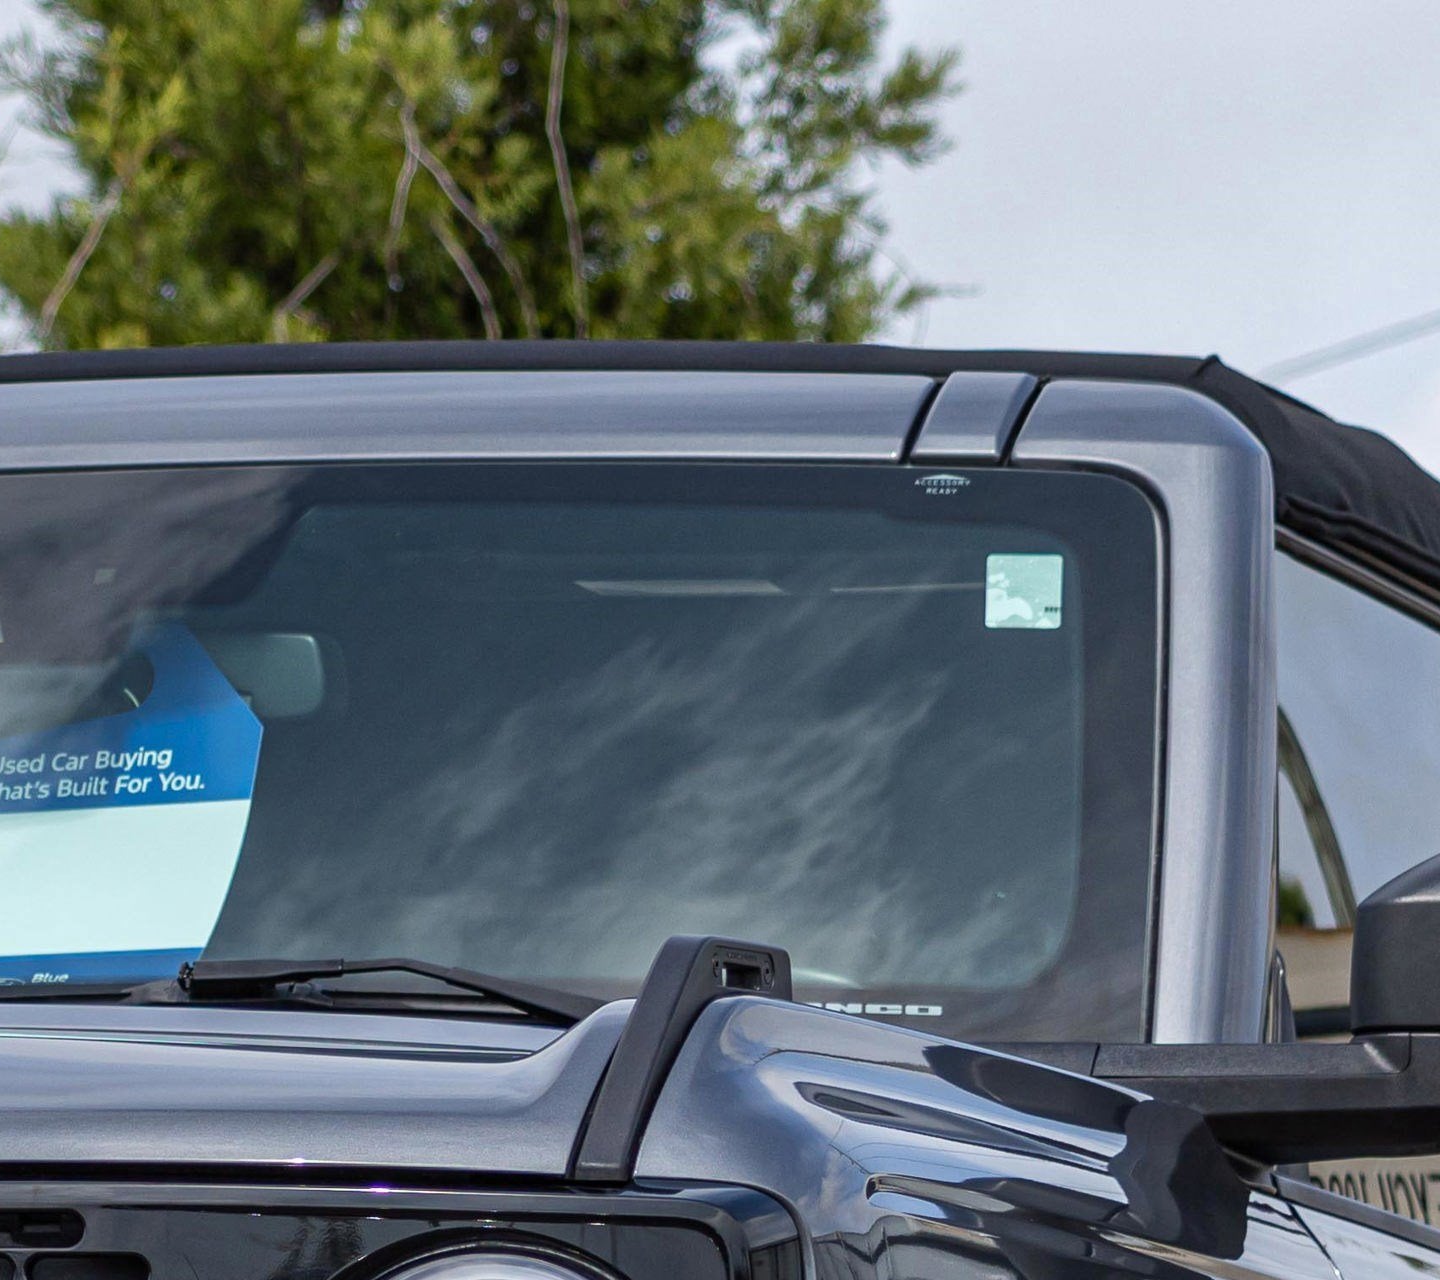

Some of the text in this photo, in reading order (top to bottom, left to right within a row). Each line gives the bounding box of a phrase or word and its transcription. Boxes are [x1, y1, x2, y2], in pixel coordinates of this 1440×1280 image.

[51, 752, 88, 771] Car
[95, 747, 173, 770] Buying
[57, 776, 108, 798] Built
[114, 775, 152, 794] For
[159, 771, 205, 792] You.
[31, 973, 69, 984] Blue
